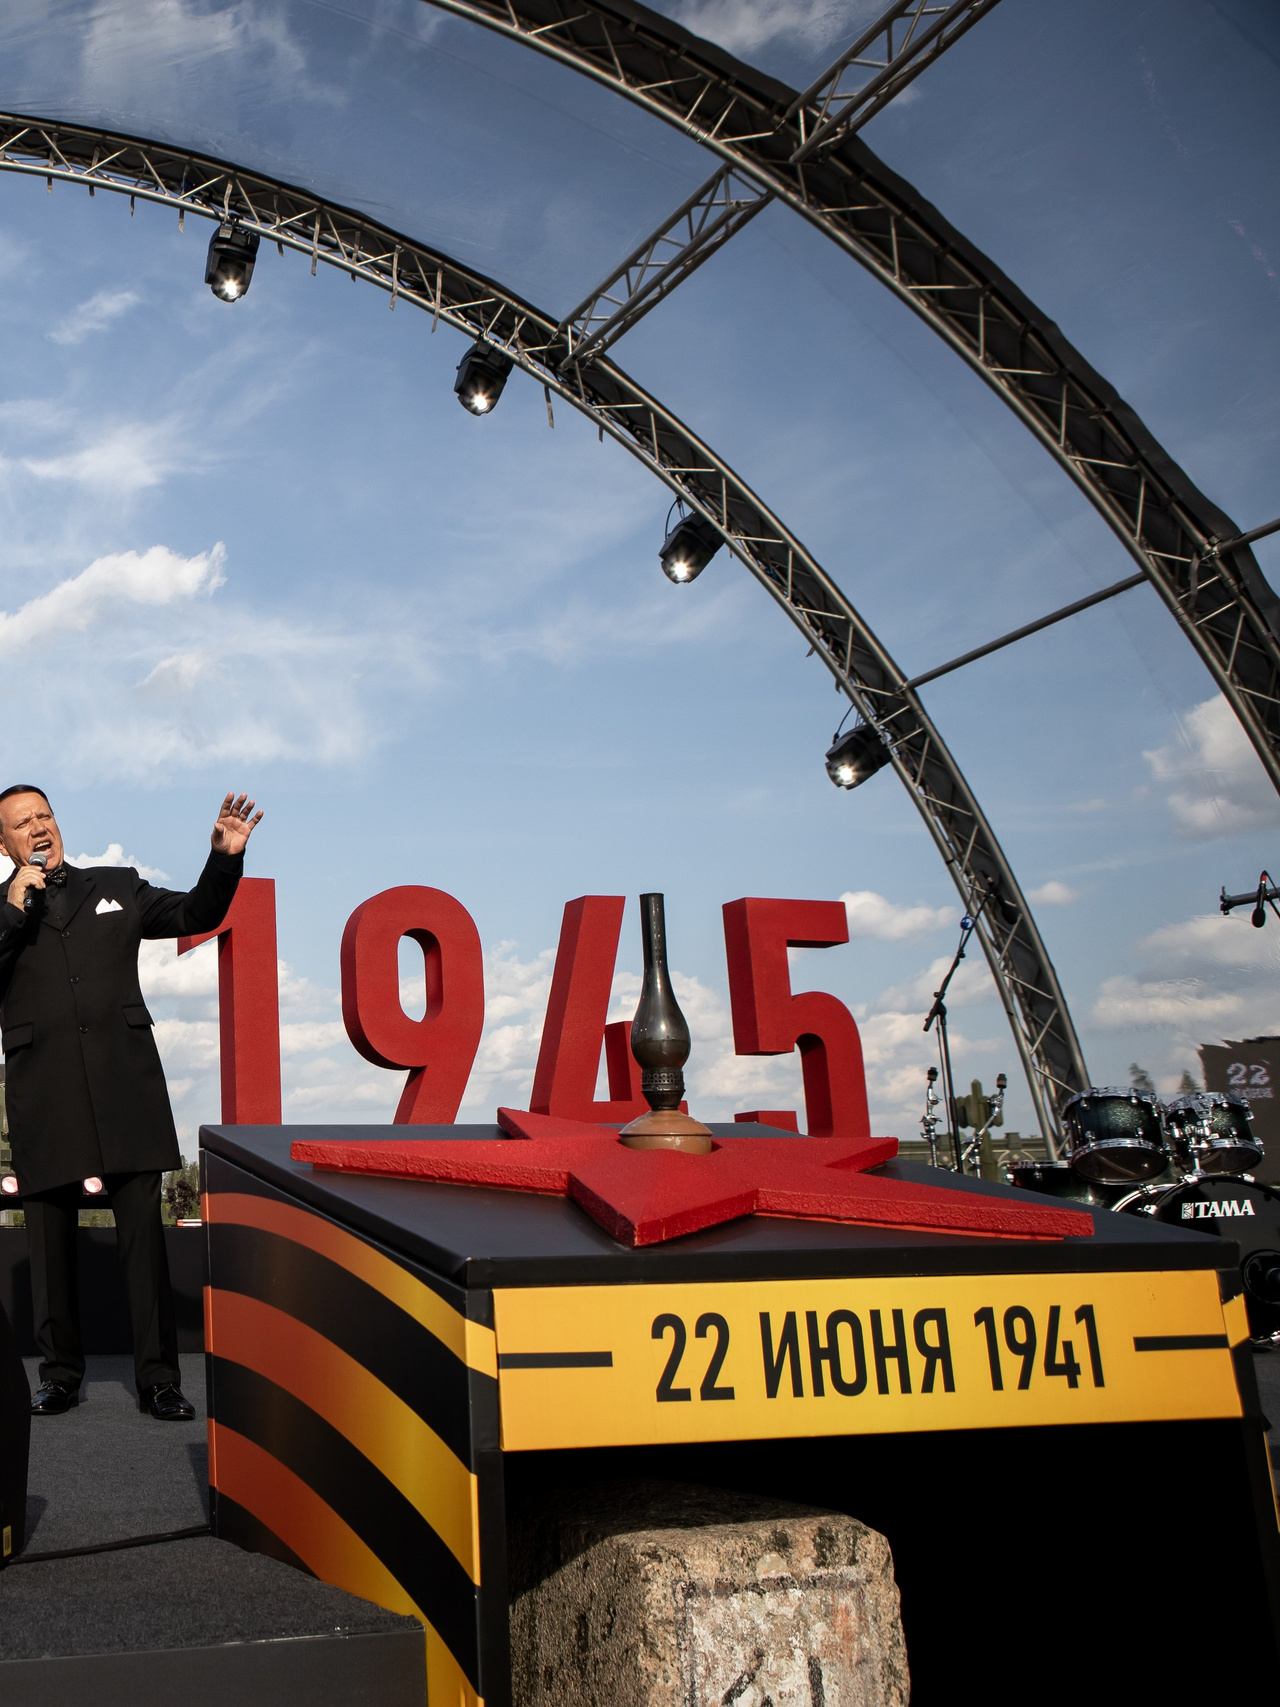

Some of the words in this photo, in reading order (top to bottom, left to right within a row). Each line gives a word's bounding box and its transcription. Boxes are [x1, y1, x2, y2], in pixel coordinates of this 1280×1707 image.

[177, 877, 870, 1138] 1945
[1227, 1063, 1270, 1085] 22
[1195, 1199, 1256, 1218] TAMA
[651, 1312, 735, 1402] 22
[760, 1307, 956, 1399] ИЮНЯ
[973, 1304, 1105, 1391] 1941
